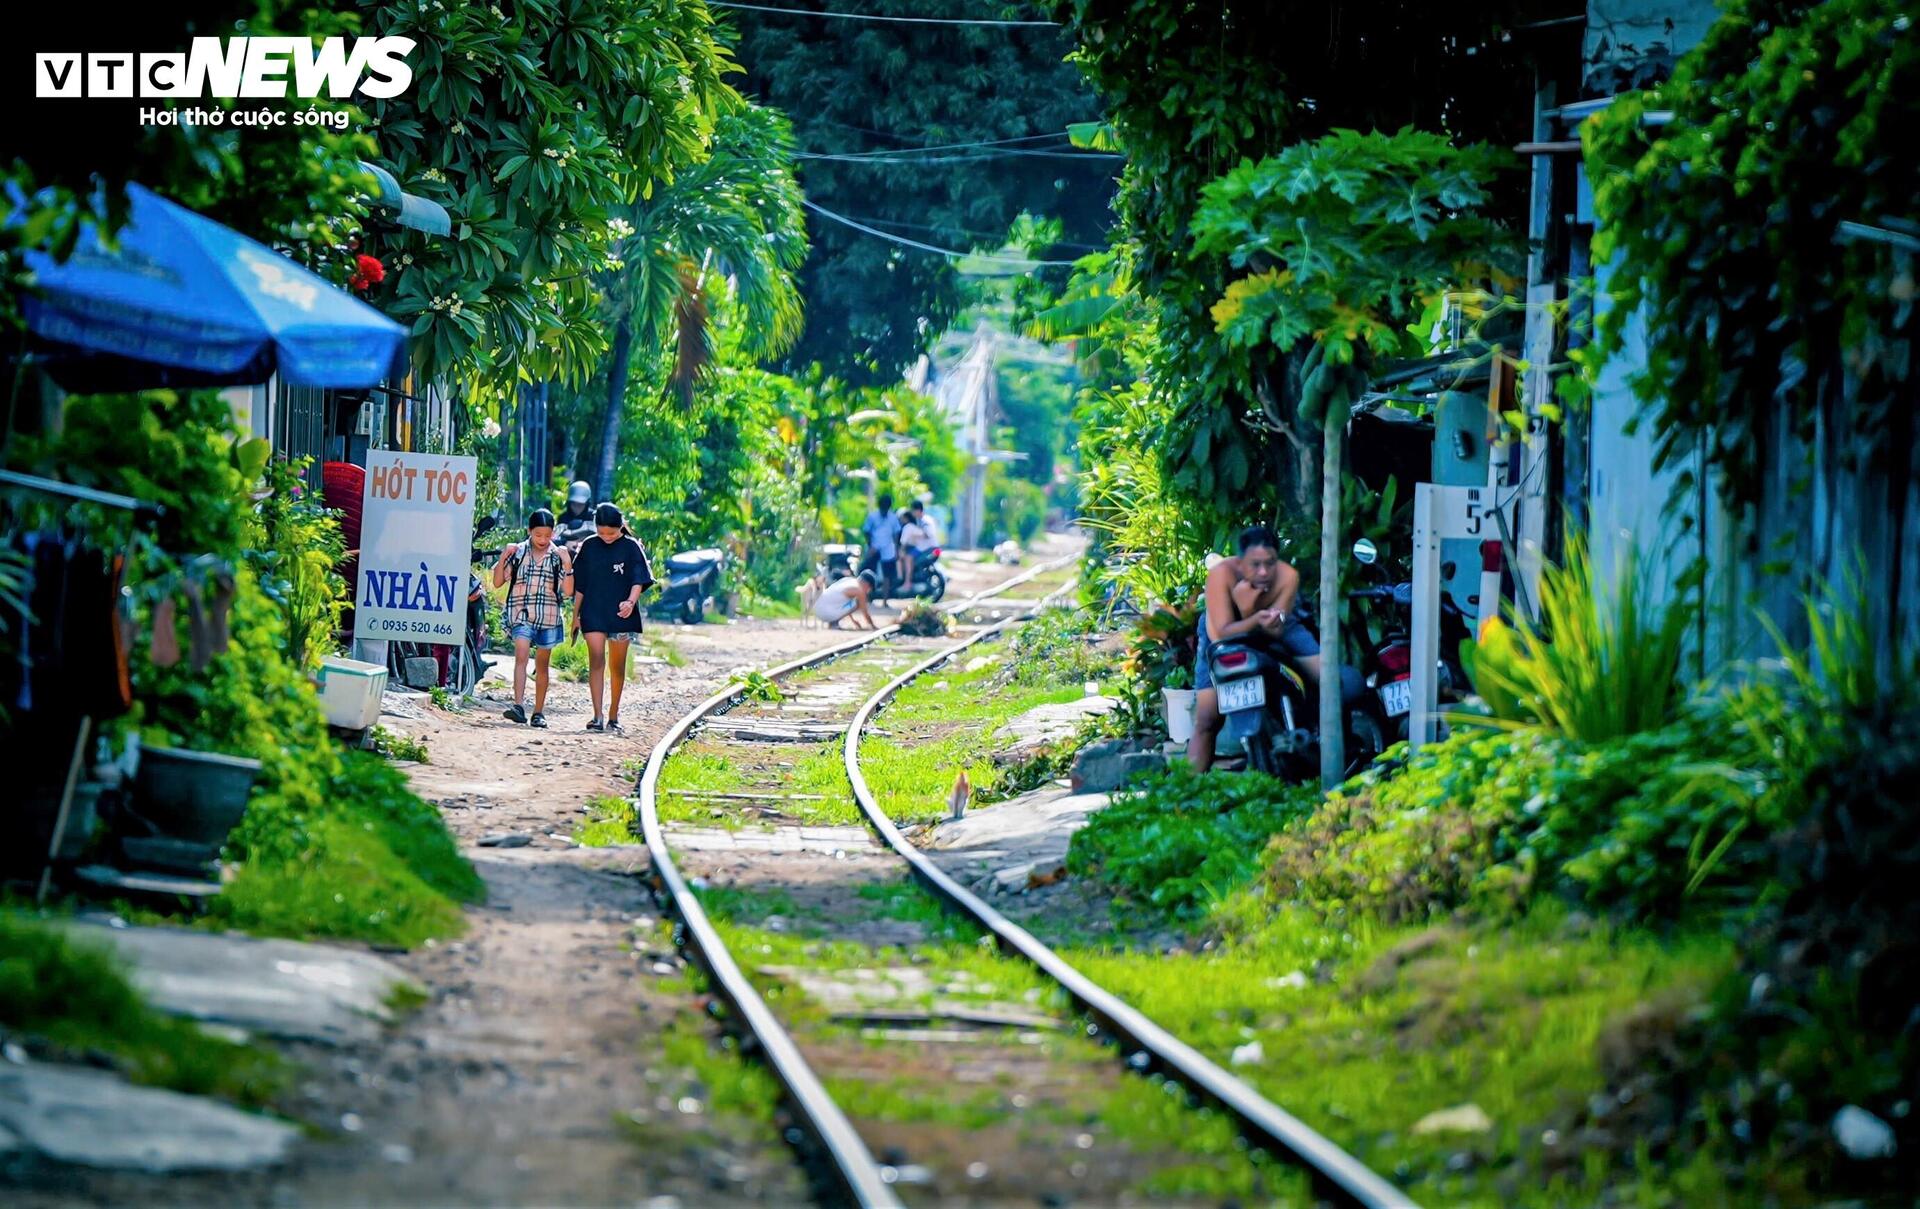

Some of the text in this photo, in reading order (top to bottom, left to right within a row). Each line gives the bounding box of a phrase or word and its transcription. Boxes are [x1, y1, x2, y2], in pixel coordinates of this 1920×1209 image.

[371, 458, 468, 505] HỚT TÓC
[1466, 503, 1482, 535] 5
[363, 561, 458, 613] NHÀN
[382, 619, 453, 635] 0935 520 466
